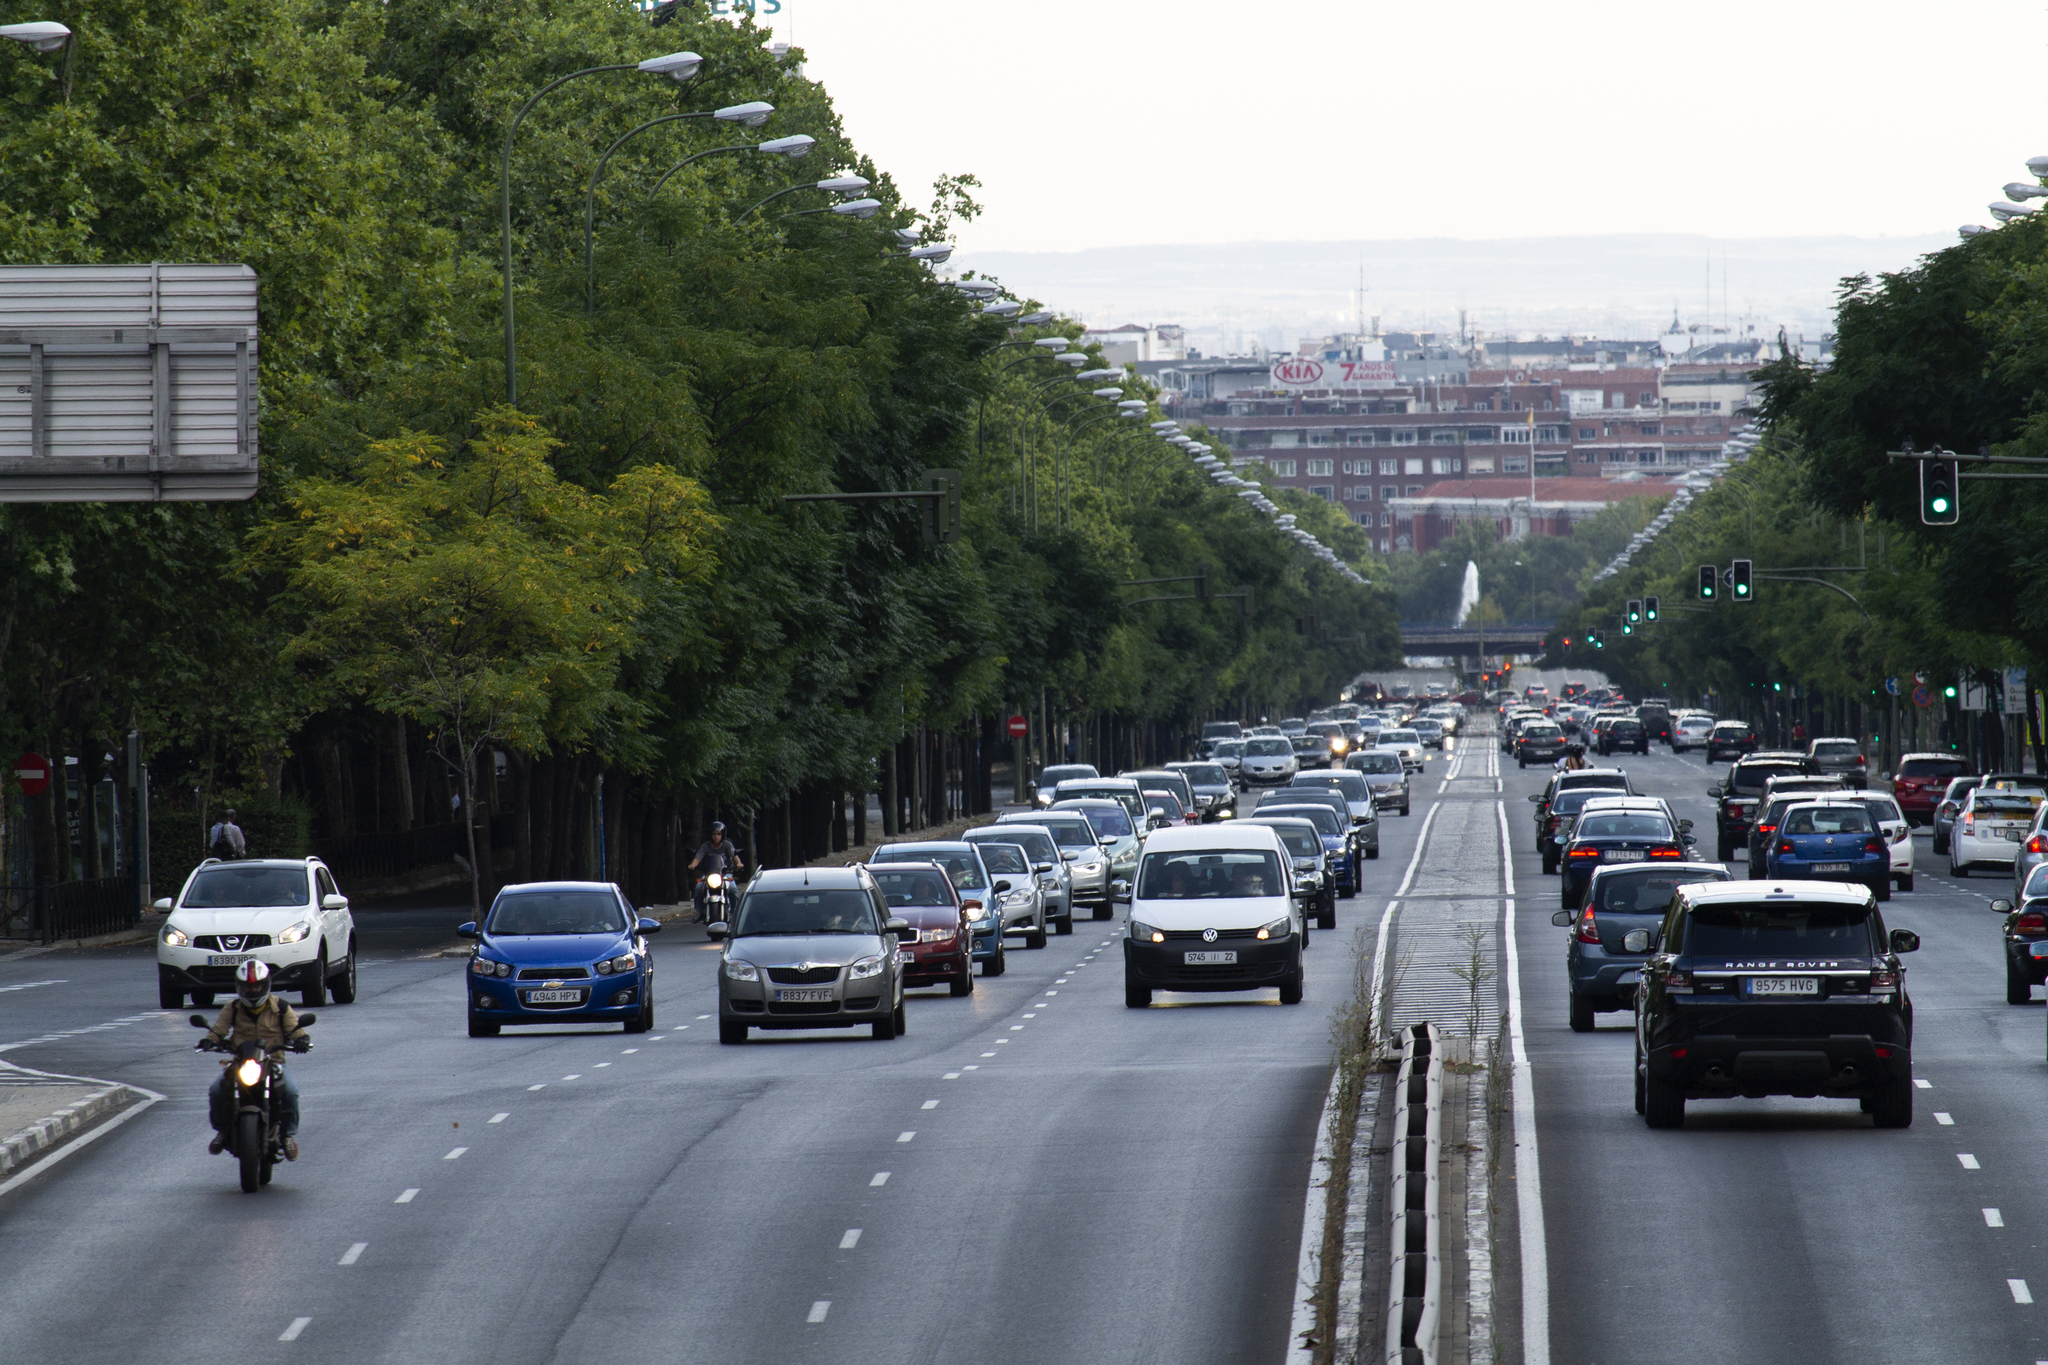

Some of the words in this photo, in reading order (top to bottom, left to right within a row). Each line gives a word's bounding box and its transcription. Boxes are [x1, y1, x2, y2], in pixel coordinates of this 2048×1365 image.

[1340, 363, 1356, 381] 7
[1384, 363, 1396, 371] DE
[213, 956, 236, 965] 8390
[1188, 953, 1206, 961] 5745
[1224, 952, 1234, 961] 22
[1756, 980, 1786, 991] 9575
[1790, 980, 1813, 991] HVG
[533, 992, 557, 1001] 4948
[560, 991, 578, 1000] HPX
[782, 991, 808, 1001] 8837
[810, 990, 829, 1000] FVF
